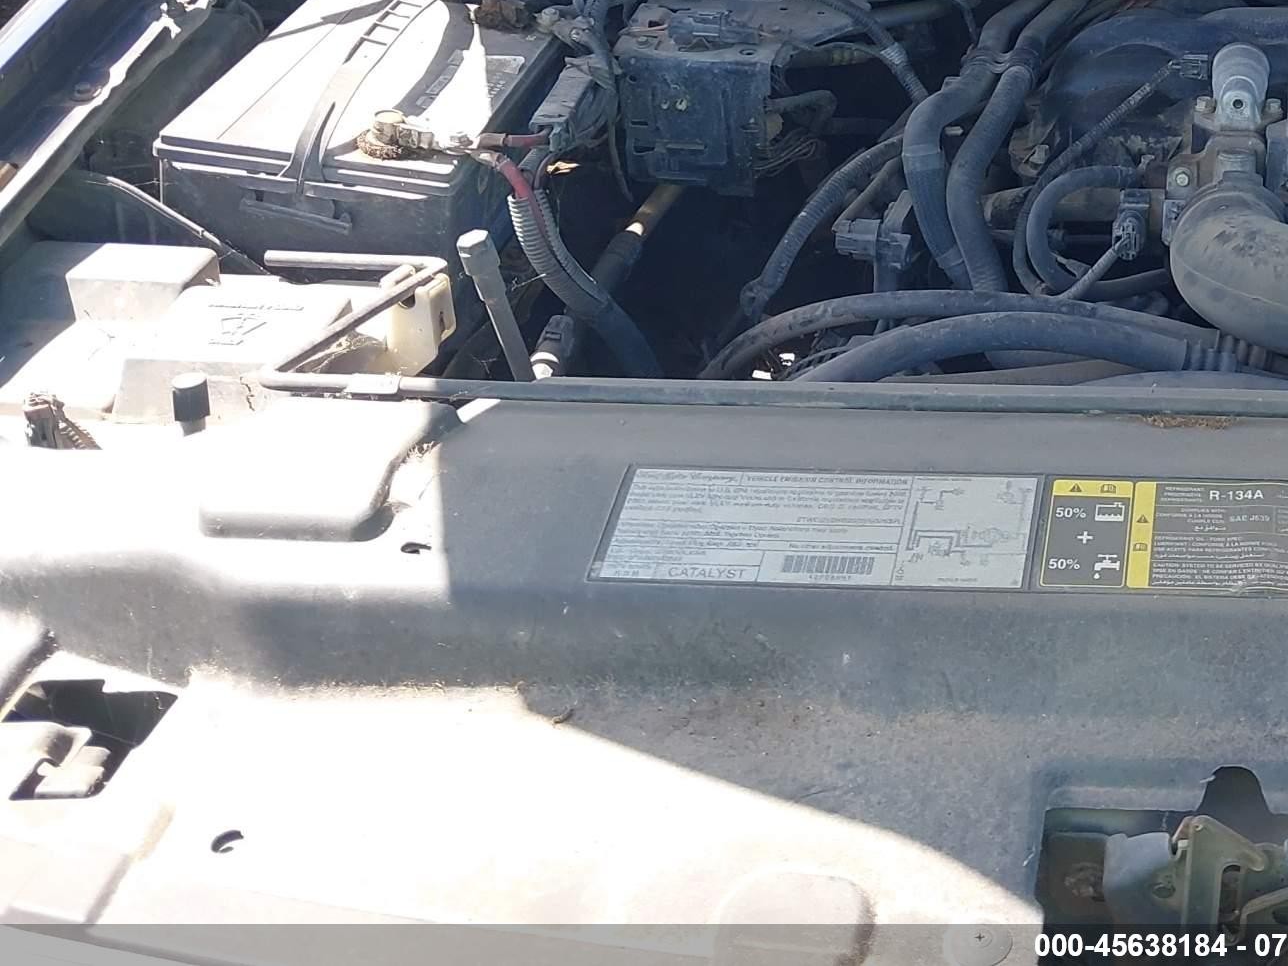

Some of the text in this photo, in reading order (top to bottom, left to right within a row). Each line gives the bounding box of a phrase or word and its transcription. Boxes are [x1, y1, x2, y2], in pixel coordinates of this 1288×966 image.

[1209, 489, 1265, 501] R-134A
[1055, 506, 1087, 519] 50%
[1048, 558, 1081, 570] 50%
[668, 566, 746, 580] CATALYST
